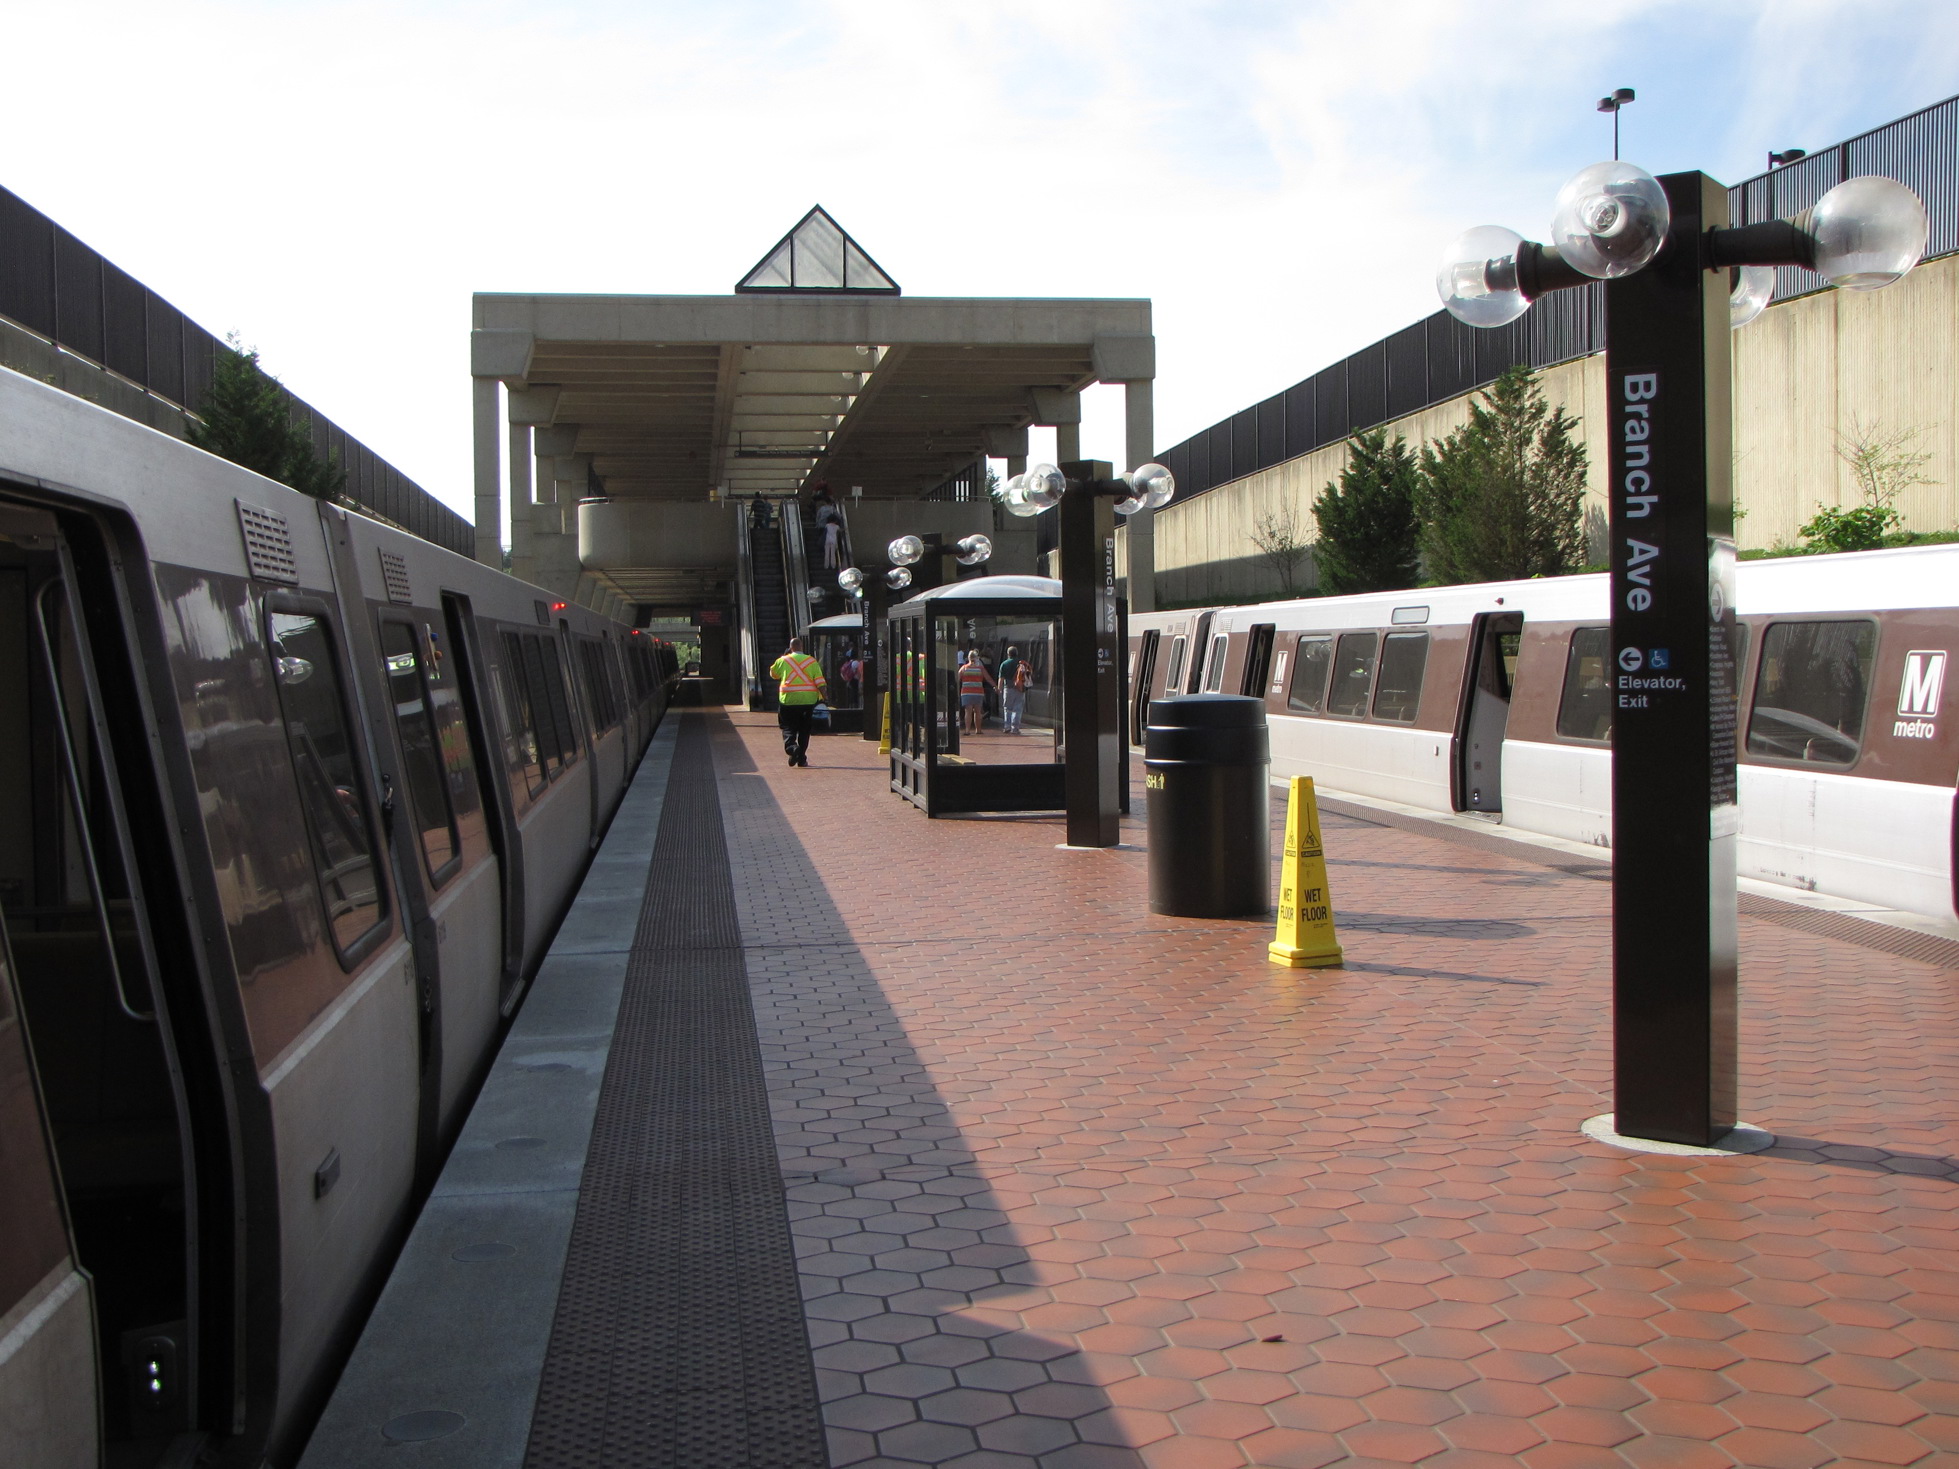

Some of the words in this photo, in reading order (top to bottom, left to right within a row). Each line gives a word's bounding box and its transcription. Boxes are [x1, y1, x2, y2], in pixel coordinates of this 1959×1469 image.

[1623, 372, 1659, 519] Branch
[1105, 537, 1115, 596] Branch
[1626, 538, 1660, 612] Ave
[1106, 605, 1115, 633] Ave
[1618, 676, 1687, 692] Elevator,
[1900, 655, 1944, 713] M
[1618, 694, 1649, 709] Exit
[1893, 719, 1935, 739] metro
[1145, 774, 1157, 789] SH
[1304, 888, 1322, 904] WET
[1280, 905, 1294, 922] FLOOR
[1301, 905, 1328, 923] FLOOR
